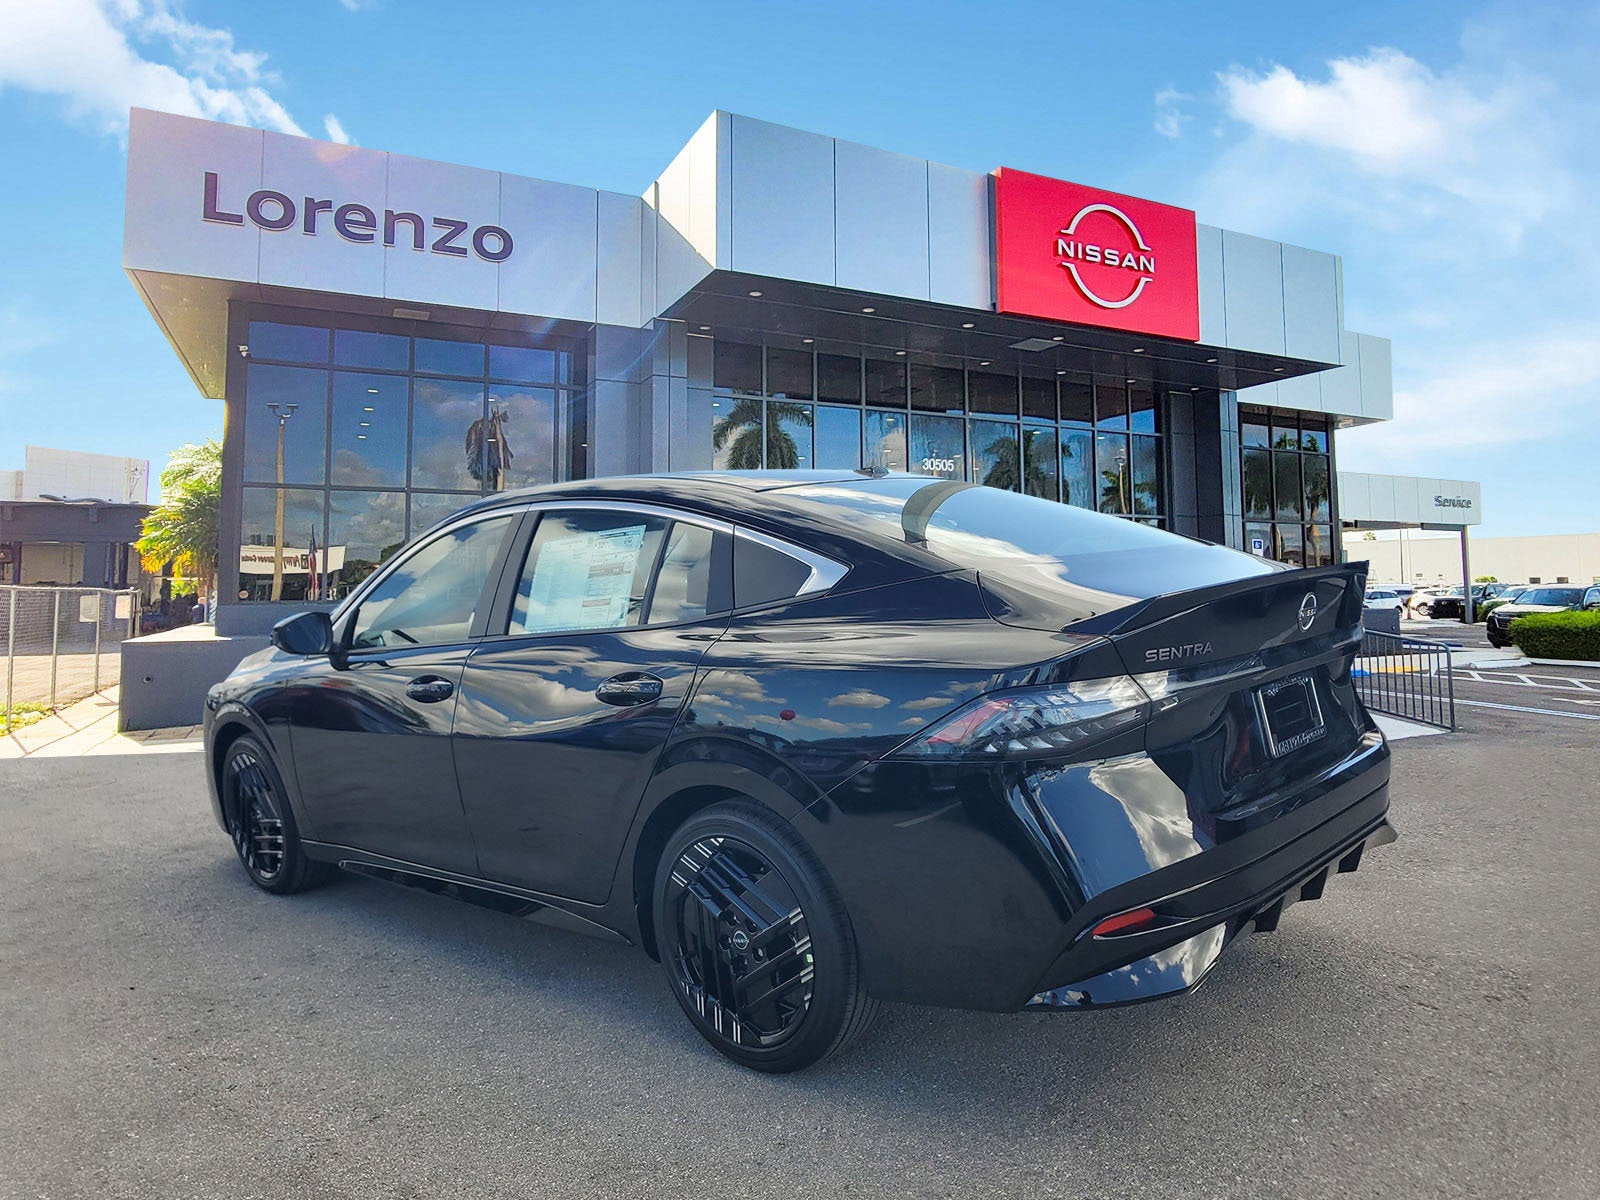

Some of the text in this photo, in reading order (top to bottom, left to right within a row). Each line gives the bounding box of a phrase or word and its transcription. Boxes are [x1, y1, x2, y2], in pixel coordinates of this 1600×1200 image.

[202, 171, 514, 262] Lorenzo
[1057, 238, 1155, 273] NISSAN
[922, 458, 954, 471] 30505
[1434, 495, 1472, 509] Service
[1144, 641, 1213, 662] SENTRA
